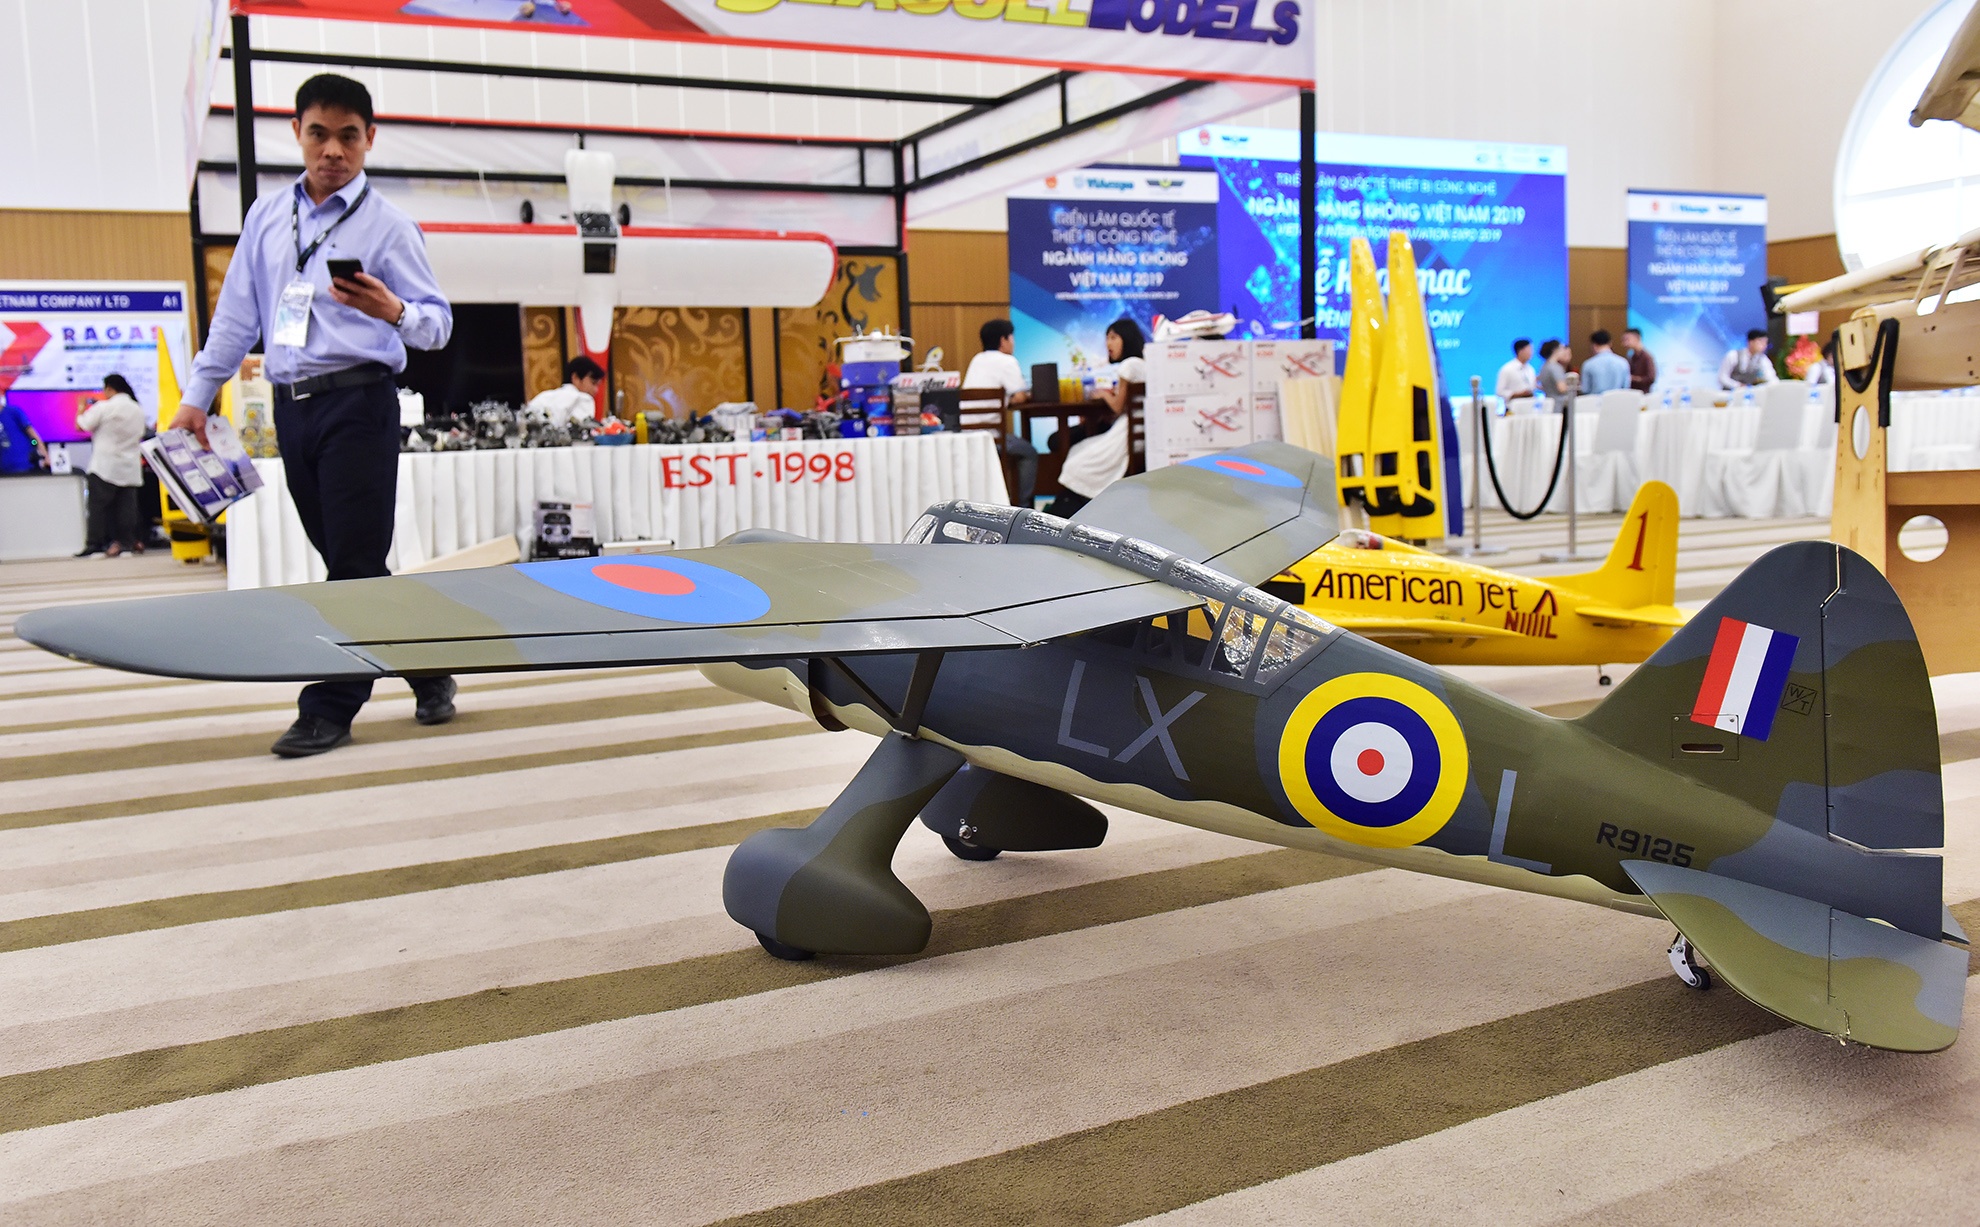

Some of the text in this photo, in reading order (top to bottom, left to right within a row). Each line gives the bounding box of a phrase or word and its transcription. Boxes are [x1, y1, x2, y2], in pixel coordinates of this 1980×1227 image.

[1454, 205, 1490, 224] NAM
[1491, 206, 1526, 225] 2019
[1099, 272, 1131, 287] NAM
[1133, 272, 1164, 287] 2019
[40, 295, 103, 309] COMPANY
[105, 295, 130, 309] LTD
[162, 295, 178, 308] A1
[1627, 509, 1649, 572] 1
[1311, 568, 1464, 607] American
[1055, 658, 1208, 782] LX
[1486, 768, 1553, 876] L
[1596, 822, 1696, 868] R9125
